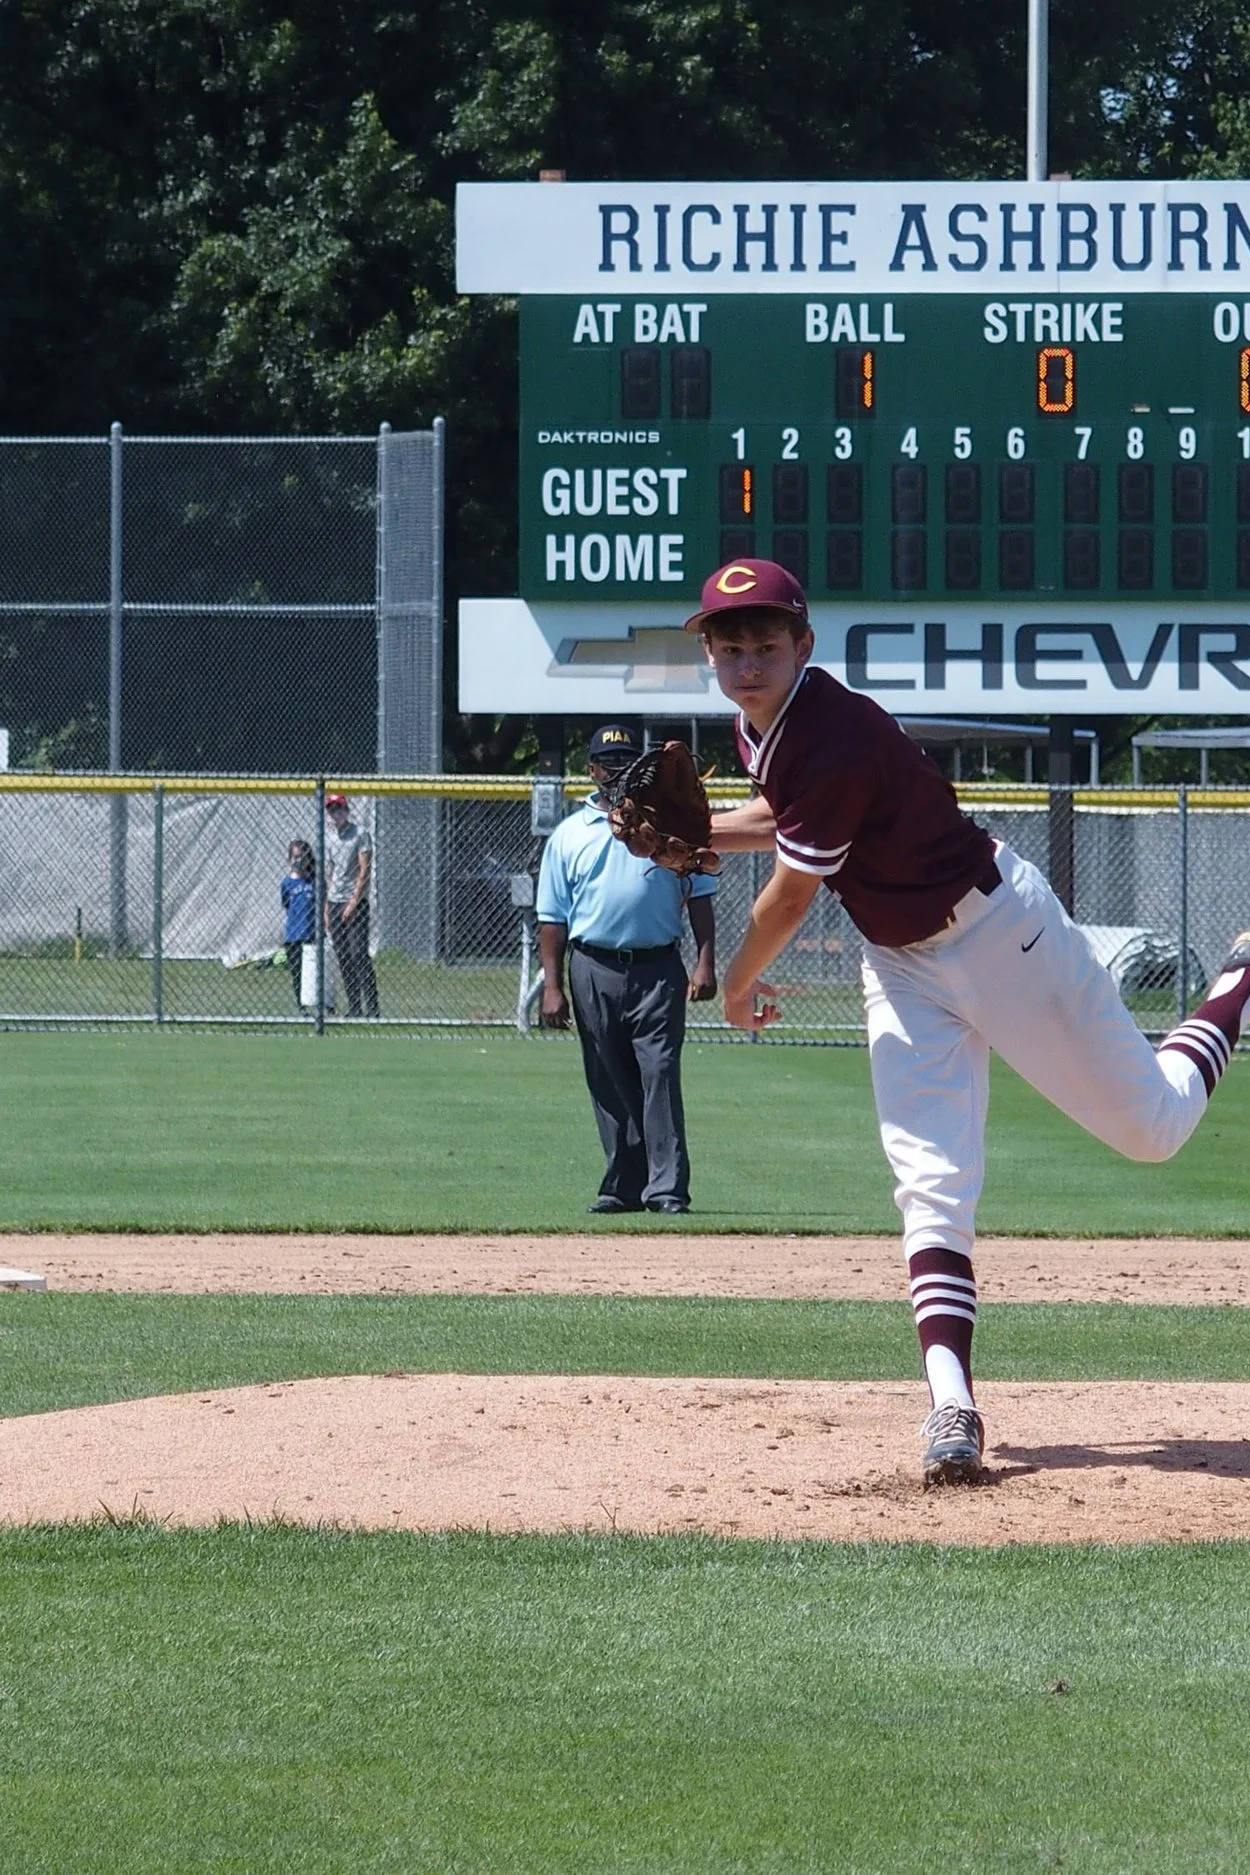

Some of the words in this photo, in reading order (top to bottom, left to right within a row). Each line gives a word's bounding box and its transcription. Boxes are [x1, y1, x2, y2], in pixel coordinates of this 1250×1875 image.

[598, 203, 858, 273] RICHIE
[572, 303, 621, 343] AT
[634, 303, 708, 343] BAT
[805, 302, 905, 343] BALL
[984, 302, 1124, 343] STRIKE
[862, 351, 873, 409] 1
[1038, 347, 1075, 412] 0
[538, 431, 660, 443] DAKTRONICS
[731, 427, 746, 460] 1
[781, 427, 800, 460] 2
[835, 427, 853, 460] 3
[900, 427, 919, 459] 4
[954, 427, 972, 459] 5
[1007, 427, 1026, 460] 6
[1074, 427, 1093, 460] 7
[1126, 426, 1145, 459] 8
[1178, 426, 1197, 459] 9
[542, 467, 688, 516] GUEST
[743, 468, 752, 514] 1
[546, 533, 684, 582] HOME
[716, 566, 757, 594] C
[602, 730, 631, 744] PIAA
